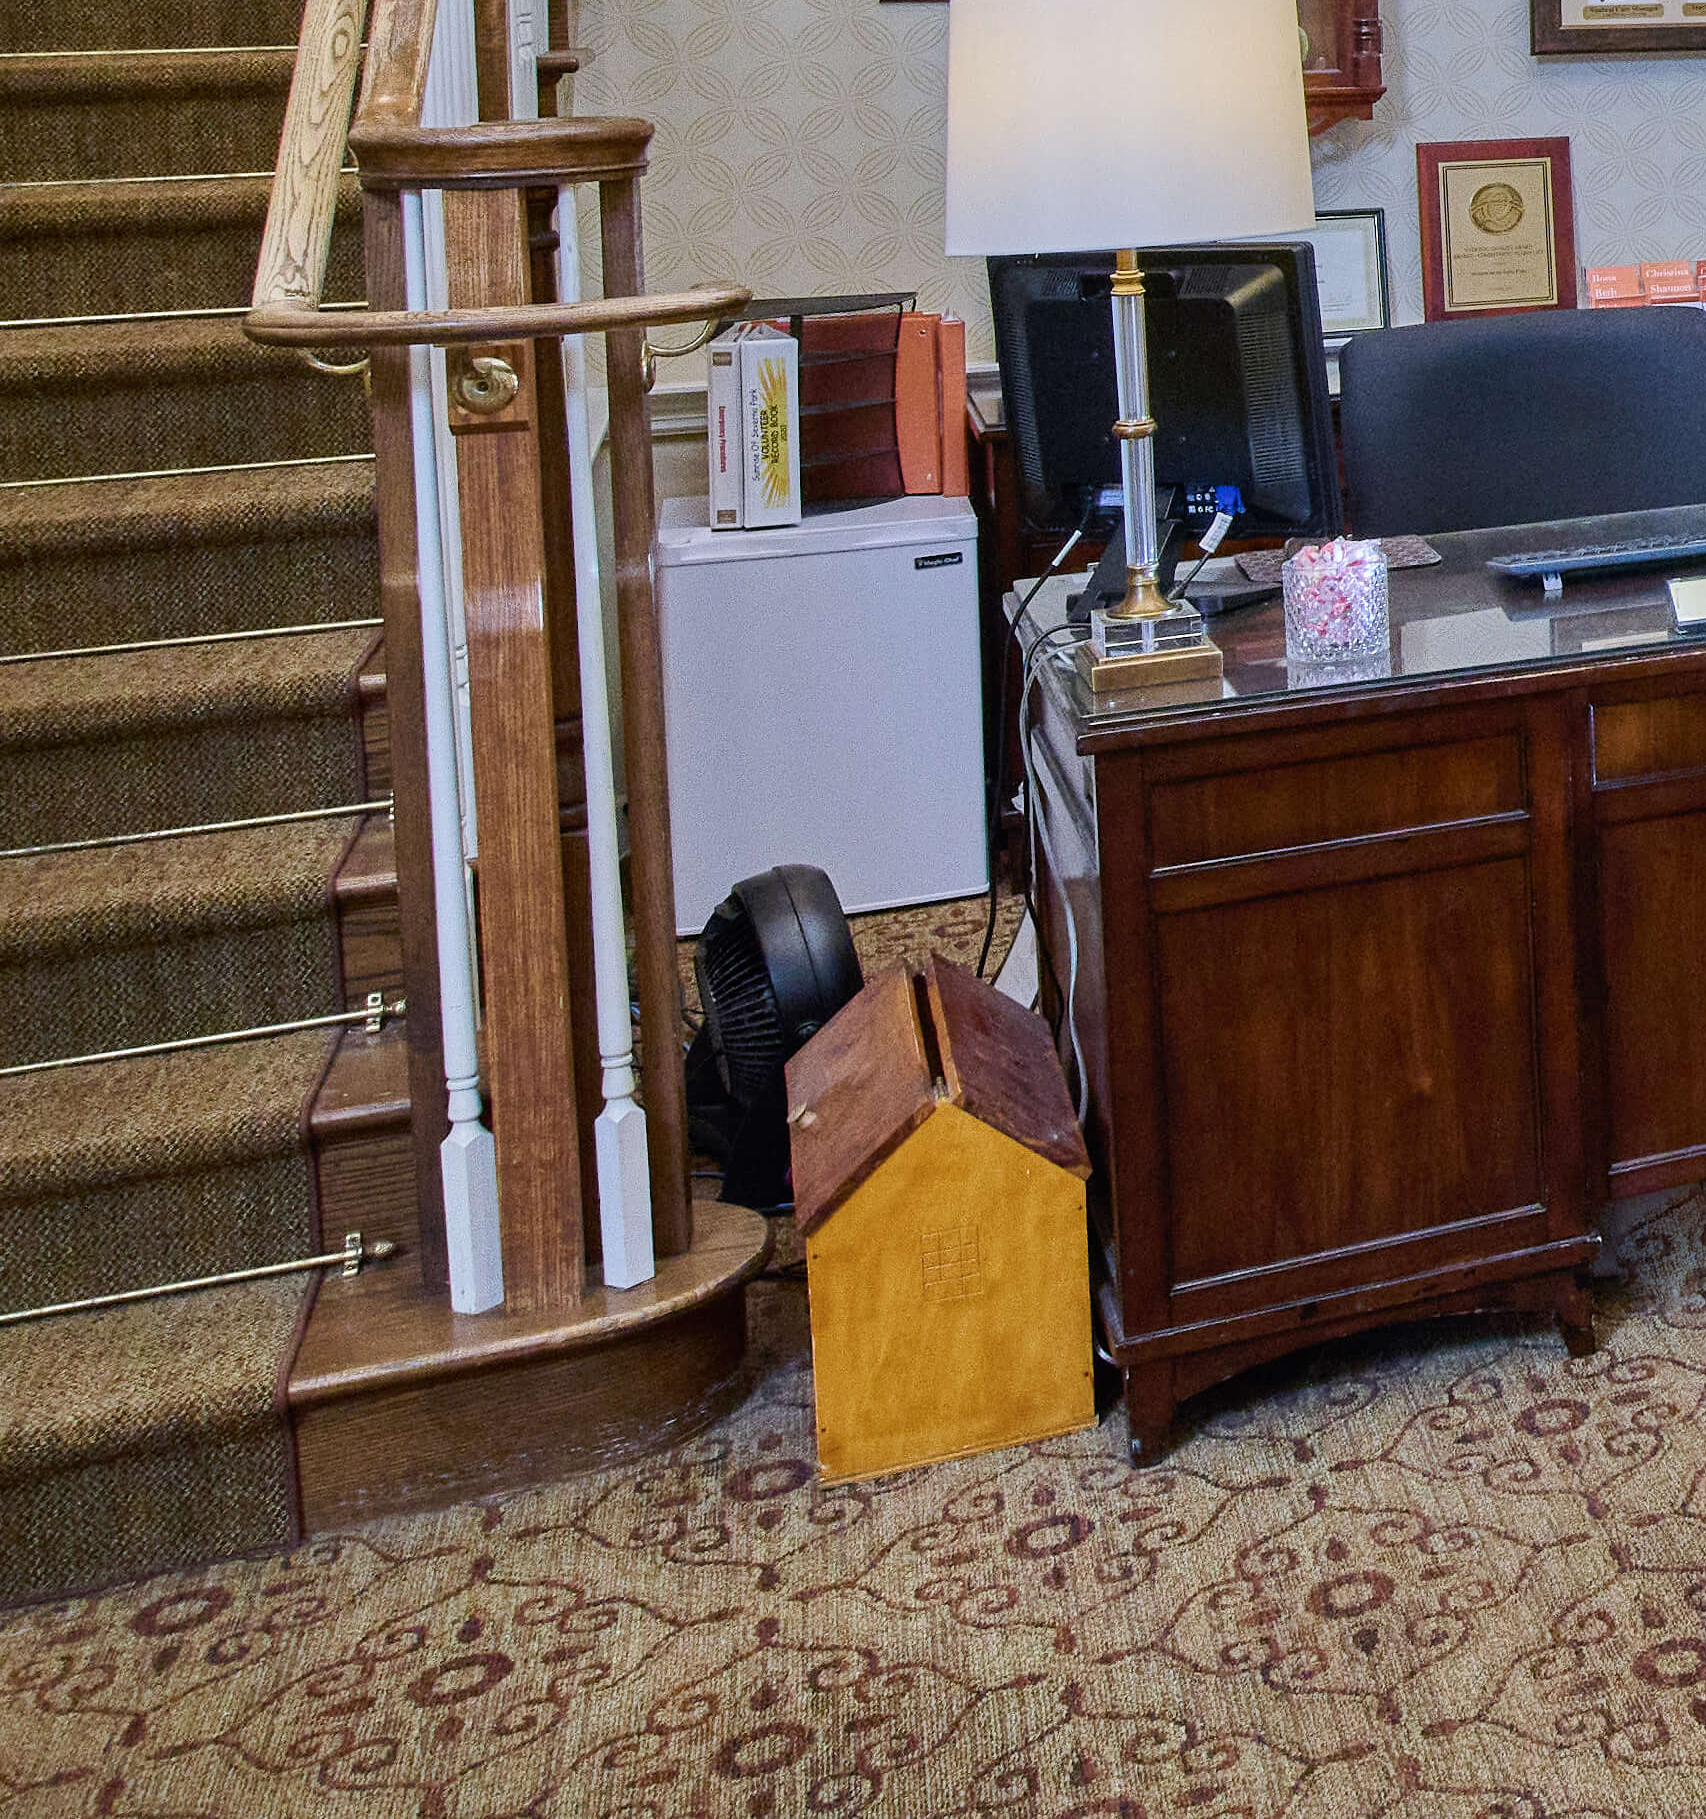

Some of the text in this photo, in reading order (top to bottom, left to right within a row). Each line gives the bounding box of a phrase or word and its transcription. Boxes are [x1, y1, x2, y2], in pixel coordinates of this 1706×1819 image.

[1646, 268, 1689, 278] Christina
[1650, 284, 1691, 294] Shannon
[750, 407, 759, 438] Severna
[760, 409, 769, 460] VOLUNTEER
[769, 404, 779, 464] RECORD BOOK
[752, 453, 761, 482] Sunrise
